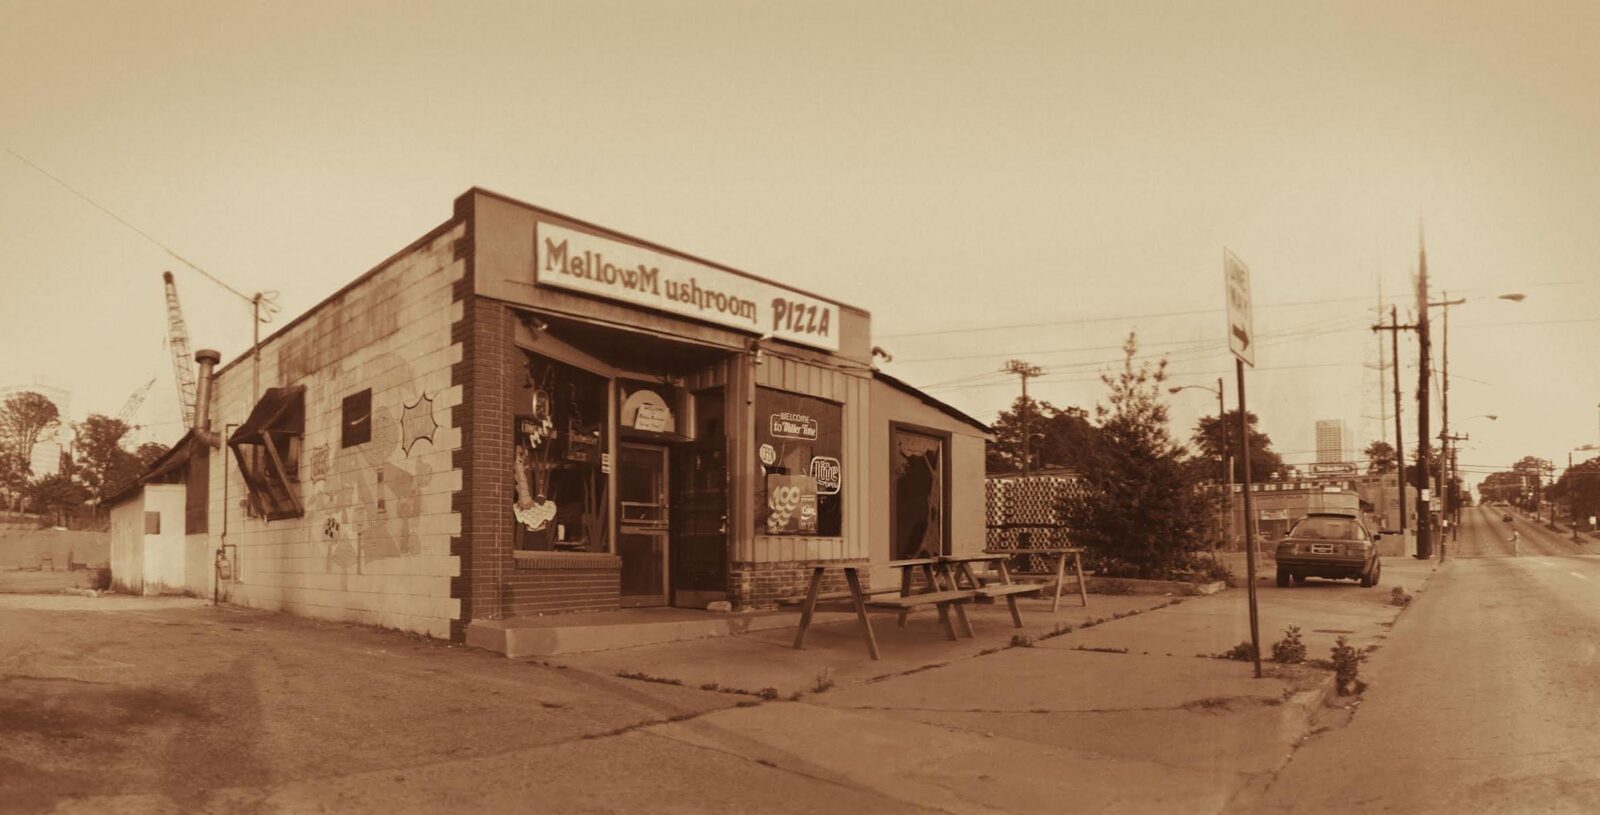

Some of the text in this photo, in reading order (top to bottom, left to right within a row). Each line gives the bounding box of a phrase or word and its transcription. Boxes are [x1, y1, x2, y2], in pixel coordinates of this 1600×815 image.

[770, 297, 831, 338] PIZZA
[780, 412, 811, 424] WELCOME
[773, 420, 817, 436] to Miller Time
[814, 460, 839, 481] Lite
